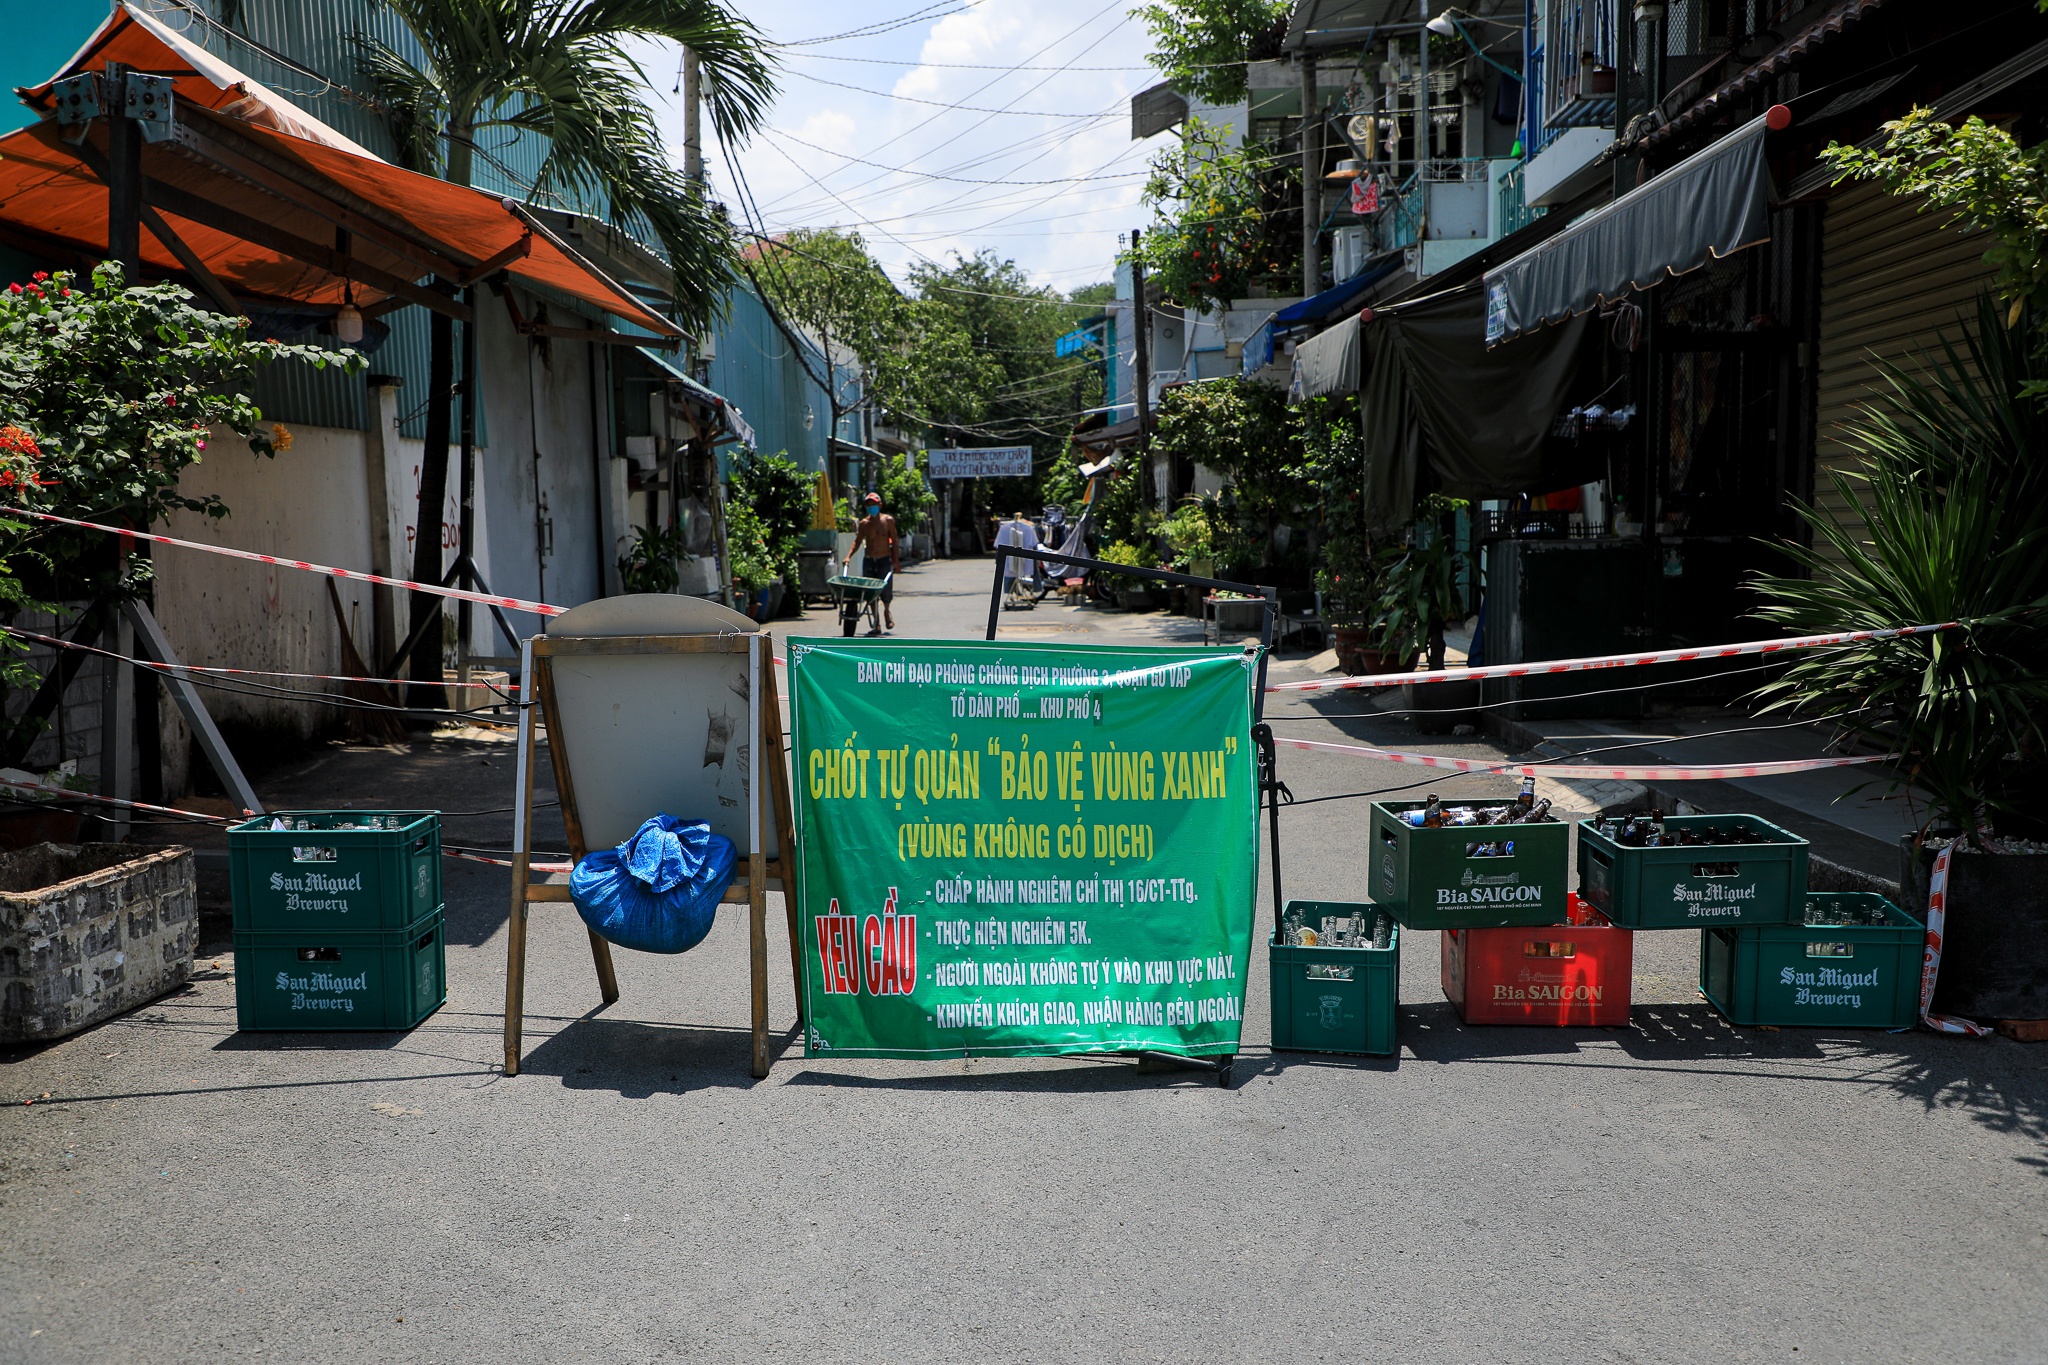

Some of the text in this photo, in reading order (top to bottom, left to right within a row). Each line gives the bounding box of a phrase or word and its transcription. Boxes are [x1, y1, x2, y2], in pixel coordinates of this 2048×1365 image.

[858, 662, 882, 683] BAN
[886, 656, 906, 684] CHỈ
[908, 663, 932, 688] ĐẠO
[936, 658, 975, 684] PHÒNG
[978, 658, 1018, 685] CHỐNG
[1022, 665, 1049, 690] DỊCH
[1052, 663, 1099, 686] PHƯỜNG
[950, 688, 966, 718] TỔ
[968, 692, 992, 718] DÂN
[996, 690, 1020, 718] PHỐ
[1040, 697, 1063, 719] KHU
[1066, 690, 1090, 719] PHỐ
[1094, 700, 1100, 720] 4
[809, 731, 870, 800] CHỐT
[877, 744, 910, 810] TỰ
[914, 732, 980, 805] QUẢN
[1056, 740, 1084, 812] VỆ
[1091, 741, 1154, 801] VÙNG
[898, 816, 1154, 866] (VÙNG KHÔNG CÓ DỊCH)
[269, 871, 362, 894] San Miguel
[936, 872, 972, 904] CHẤP
[976, 874, 1014, 904] HÀNH
[1018, 874, 1072, 904] NGHIÊM
[1076, 872, 1098, 903] CHỈ
[1102, 880, 1124, 908] THỊ
[1128, 878, 1198, 904] 16/CT-TTg.
[1672, 882, 1756, 903] San Miguel
[285, 894, 349, 914] Brewery
[1436, 886, 1542, 904] Bia SAIGON
[1688, 902, 1742, 918] Brewery
[814, 886, 918, 996] YÊU CẦU
[935, 919, 970, 950] THỰC
[974, 916, 1008, 950] HIỆN
[1012, 916, 1066, 945] NGHIÊM
[1070, 920, 1092, 944] 5K.
[275, 970, 368, 994] San Miguel
[936, 957, 979, 986] NGƯỜI
[982, 958, 1026, 986] NGOÀI
[1030, 957, 1078, 985] KHÔNG
[1080, 959, 1098, 990] TỰ
[1102, 956, 1110, 984] Ý
[1114, 956, 1142, 984] VÀO
[1144, 960, 1173, 984] KHU
[1176, 956, 1202, 988] VỰC
[1206, 951, 1236, 980] NÀY.
[1780, 966, 1879, 990] San Miguel
[291, 993, 354, 1013] Brewery
[1492, 984, 1603, 1000] Bia SAIGON
[1794, 987, 1862, 1008] Brewery
[936, 996, 993, 1028] KHUYẾN
[996, 998, 1040, 1026] KHÍCH
[1044, 1002, 1080, 1028] GIAO,
[1083, 995, 1122, 1028] NHẬN
[1125, 996, 1163, 1026] HÀNG
[1166, 996, 1195, 1026] BÊN
[1198, 992, 1242, 1023] NGOÀI.
